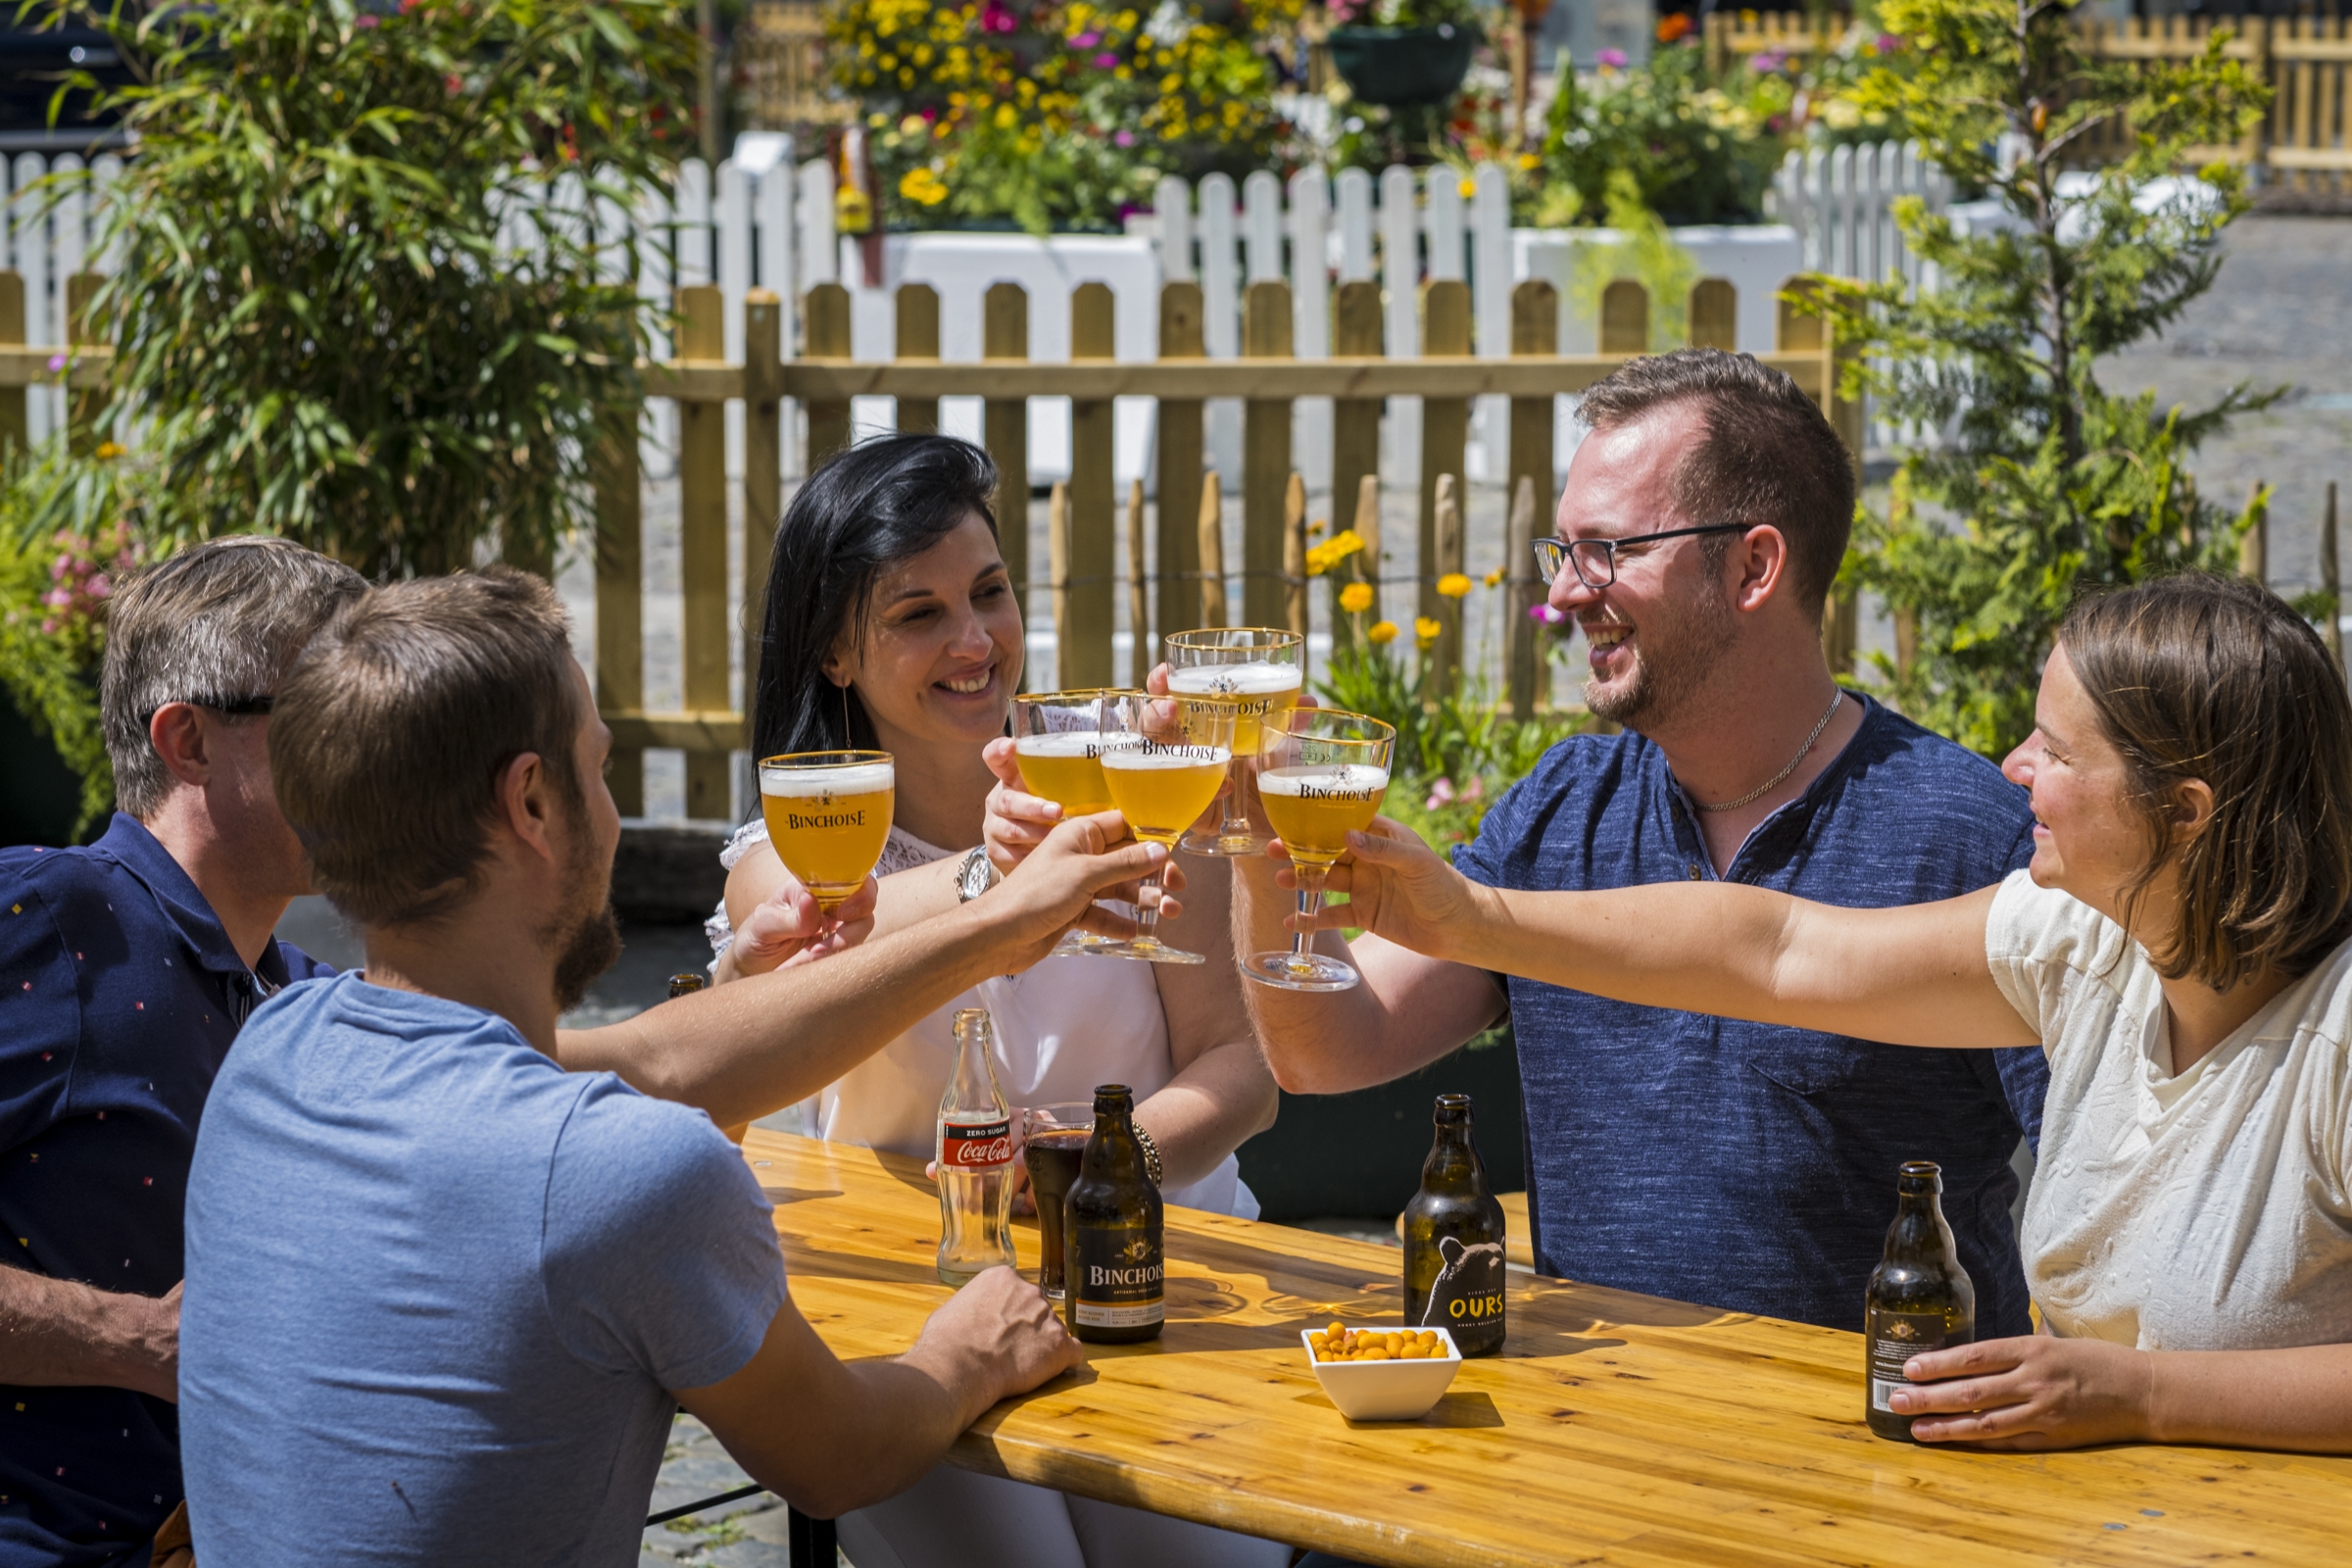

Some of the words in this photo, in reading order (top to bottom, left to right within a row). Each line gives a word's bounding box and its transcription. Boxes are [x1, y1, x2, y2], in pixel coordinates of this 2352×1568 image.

[1142, 739, 1218, 761] BINCHOISE
[1299, 784, 1374, 802] BINCHOISE
[788, 809, 865, 829] BINCHOISE
[987, 1126, 1005, 1135] SUGAR
[1090, 1263, 1164, 1286] BINCHOIS
[1449, 1293, 1503, 1318] OURS
